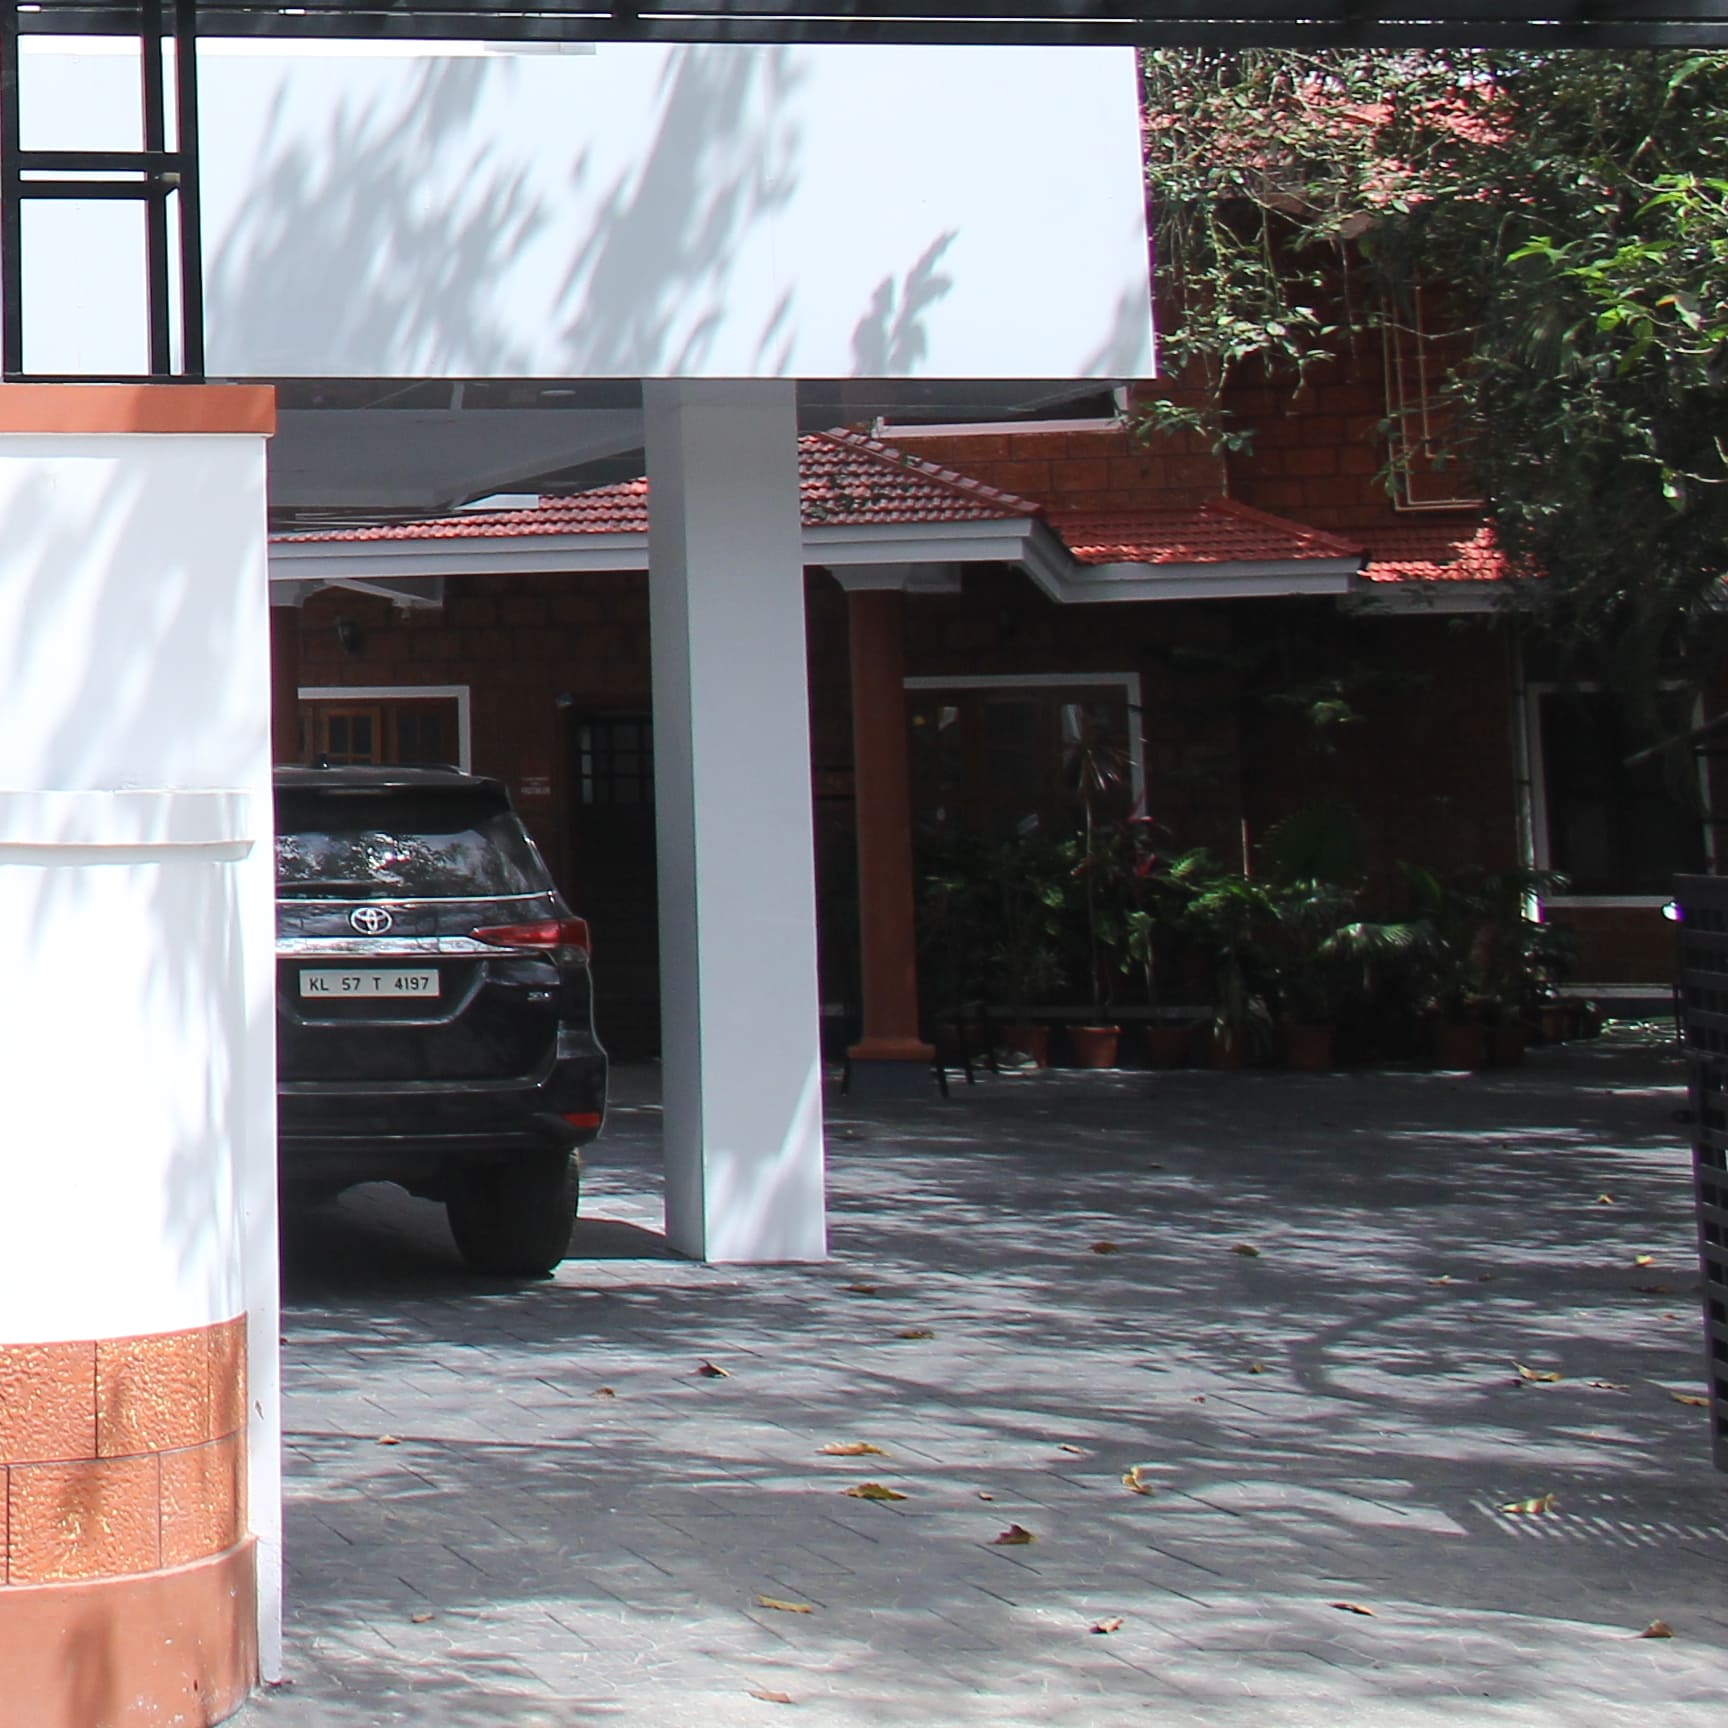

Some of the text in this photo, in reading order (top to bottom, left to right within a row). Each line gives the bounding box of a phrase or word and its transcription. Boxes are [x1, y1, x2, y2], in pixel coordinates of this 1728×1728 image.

[310, 976, 429, 991] KL 57 T 4197
